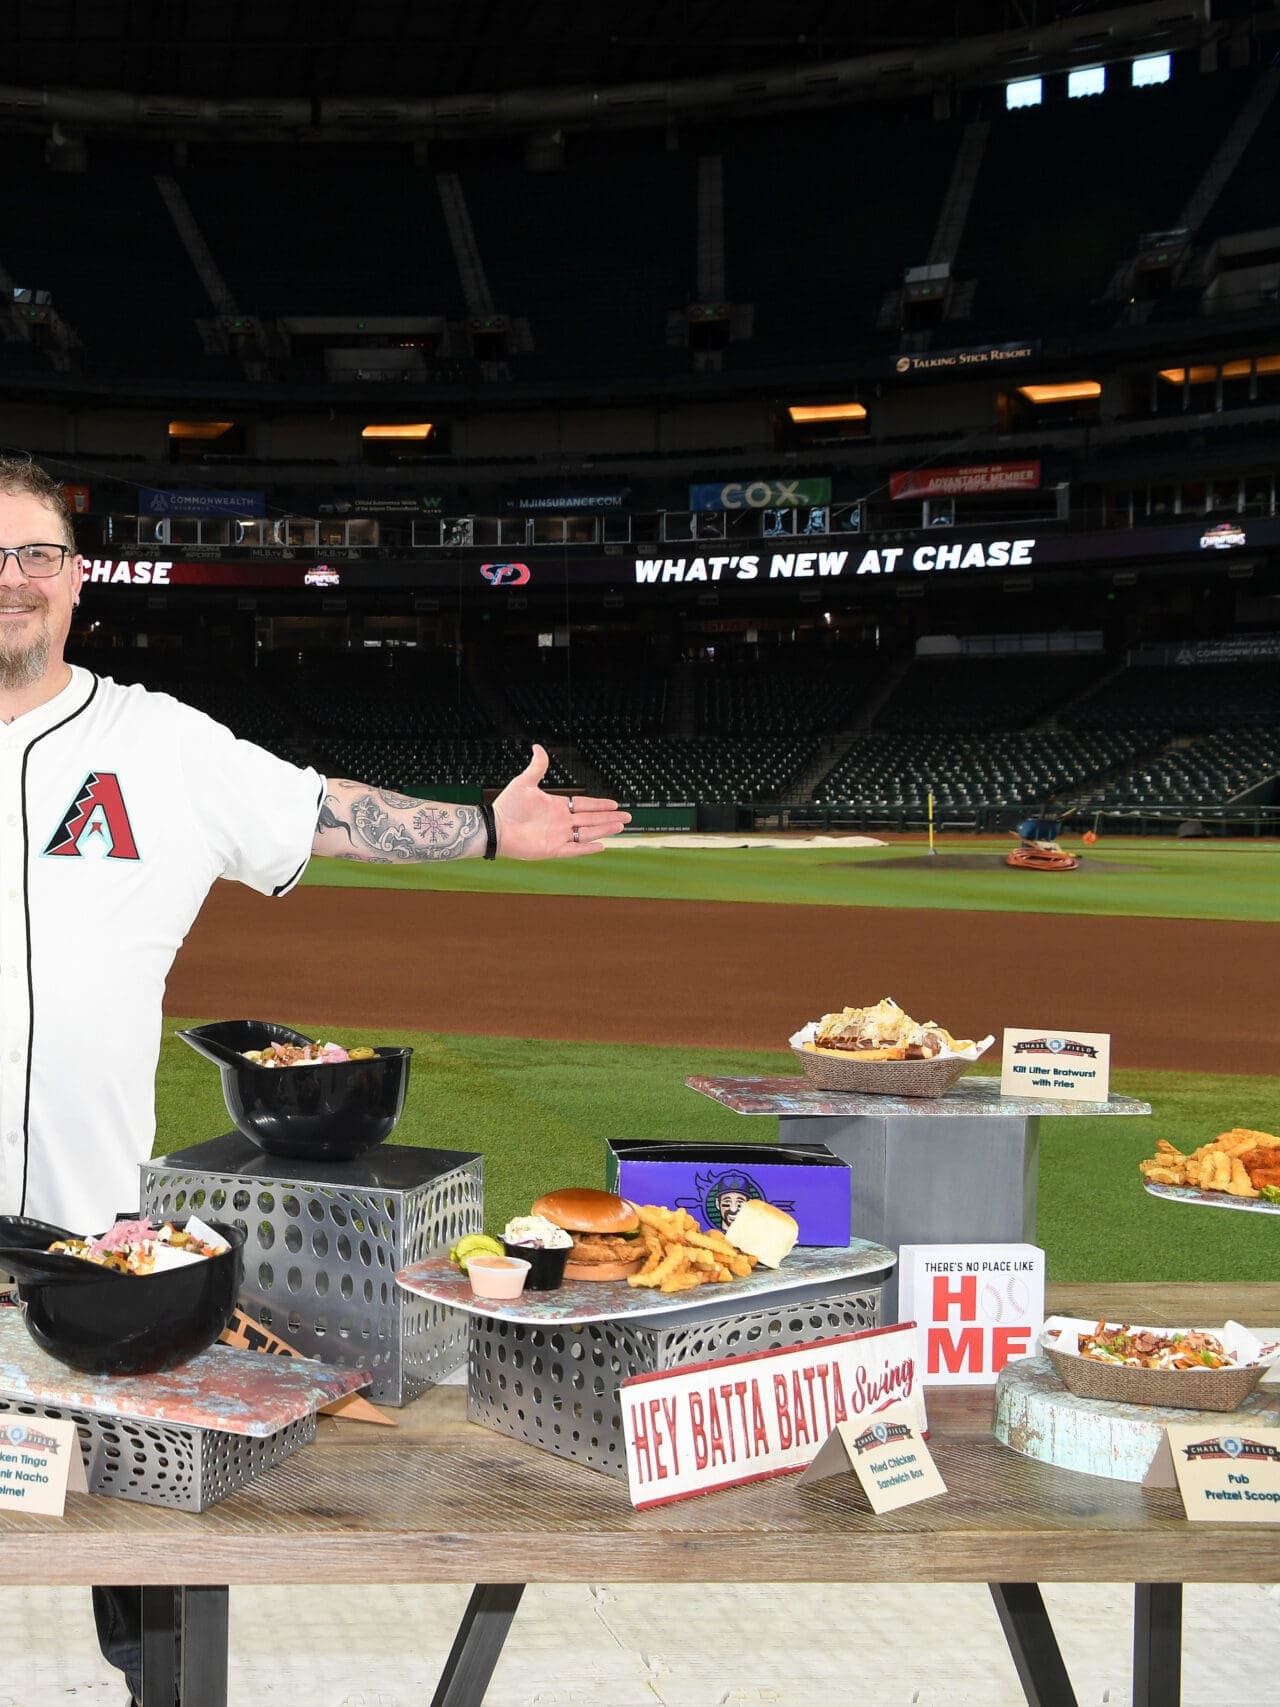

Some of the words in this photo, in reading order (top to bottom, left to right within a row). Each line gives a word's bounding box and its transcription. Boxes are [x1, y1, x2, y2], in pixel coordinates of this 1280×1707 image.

[911, 356, 957, 368] TALKING
[959, 353, 989, 364] STICK
[991, 348, 1033, 360] RESORT
[928, 475, 987, 488] ADVANTAGE
[991, 470, 1034, 482] MEMBER
[721, 480, 801, 509] COX
[170, 496, 254, 507] COMMONWEALTH
[634, 555, 760, 583] WHAT'S
[769, 551, 849, 578] NEW
[856, 548, 905, 575] AT
[912, 539, 1036, 572] CHASE
[1067, 1045, 1092, 1053] FIELD
[1013, 1065, 1026, 1073] Kilt
[1029, 1066, 1051, 1075] Lifter
[1053, 1068, 1096, 1078] Bratwurst
[1054, 1080, 1075, 1088] Fries
[925, 1261, 963, 1272] THERE'S
[966, 1261, 980, 1272] NO
[982, 1261, 1012, 1271] PLACE
[1014, 1261, 1034, 1271] LIKE
[631, 1396, 680, 1484] HEY
[688, 1378, 770, 1470] BATTA
[773, 1361, 847, 1451] BATTA
[852, 1356, 916, 1415] Swing
[29, 1436, 54, 1447] FIELD
[1191, 1445, 1218, 1453] CHASE
[1245, 1446, 1274, 1454] FIELD
[21, 1454, 47, 1467] Tinga
[870, 1462, 888, 1475] Fried
[887, 1454, 917, 1468] Chicken
[15, 1470, 49, 1484] Nacho
[877, 1472, 911, 1489] Sandwich
[909, 1469, 924, 1480] Box
[1228, 1473, 1249, 1484] Pub
[1205, 1490, 1242, 1500] Pretzel
[1244, 1490, 1280, 1503] Scoop
